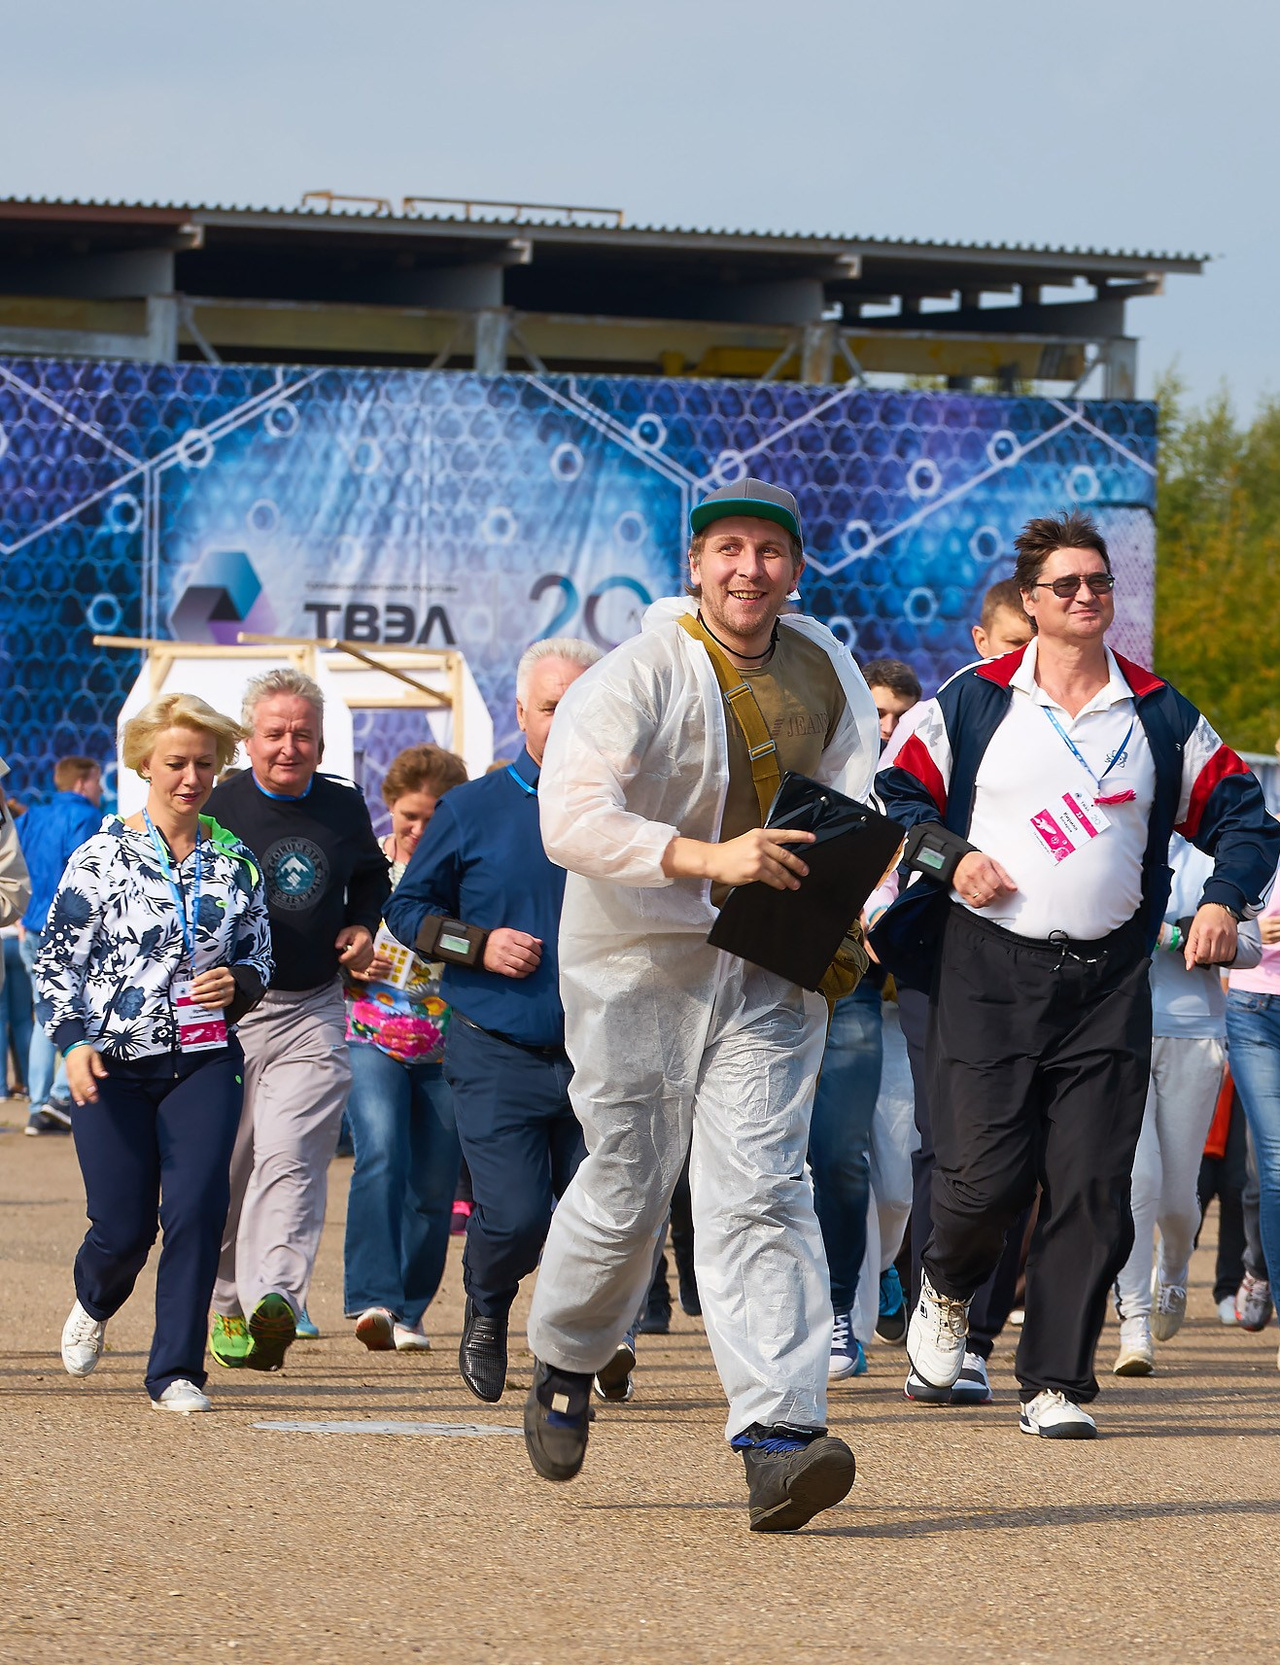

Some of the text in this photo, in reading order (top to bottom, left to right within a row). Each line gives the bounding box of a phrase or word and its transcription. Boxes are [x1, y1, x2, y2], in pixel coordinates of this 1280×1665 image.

[304, 603, 456, 645] ТВЭЛ
[530, 574, 653, 651] 20
[269, 843, 320, 867] COLUMBIA
